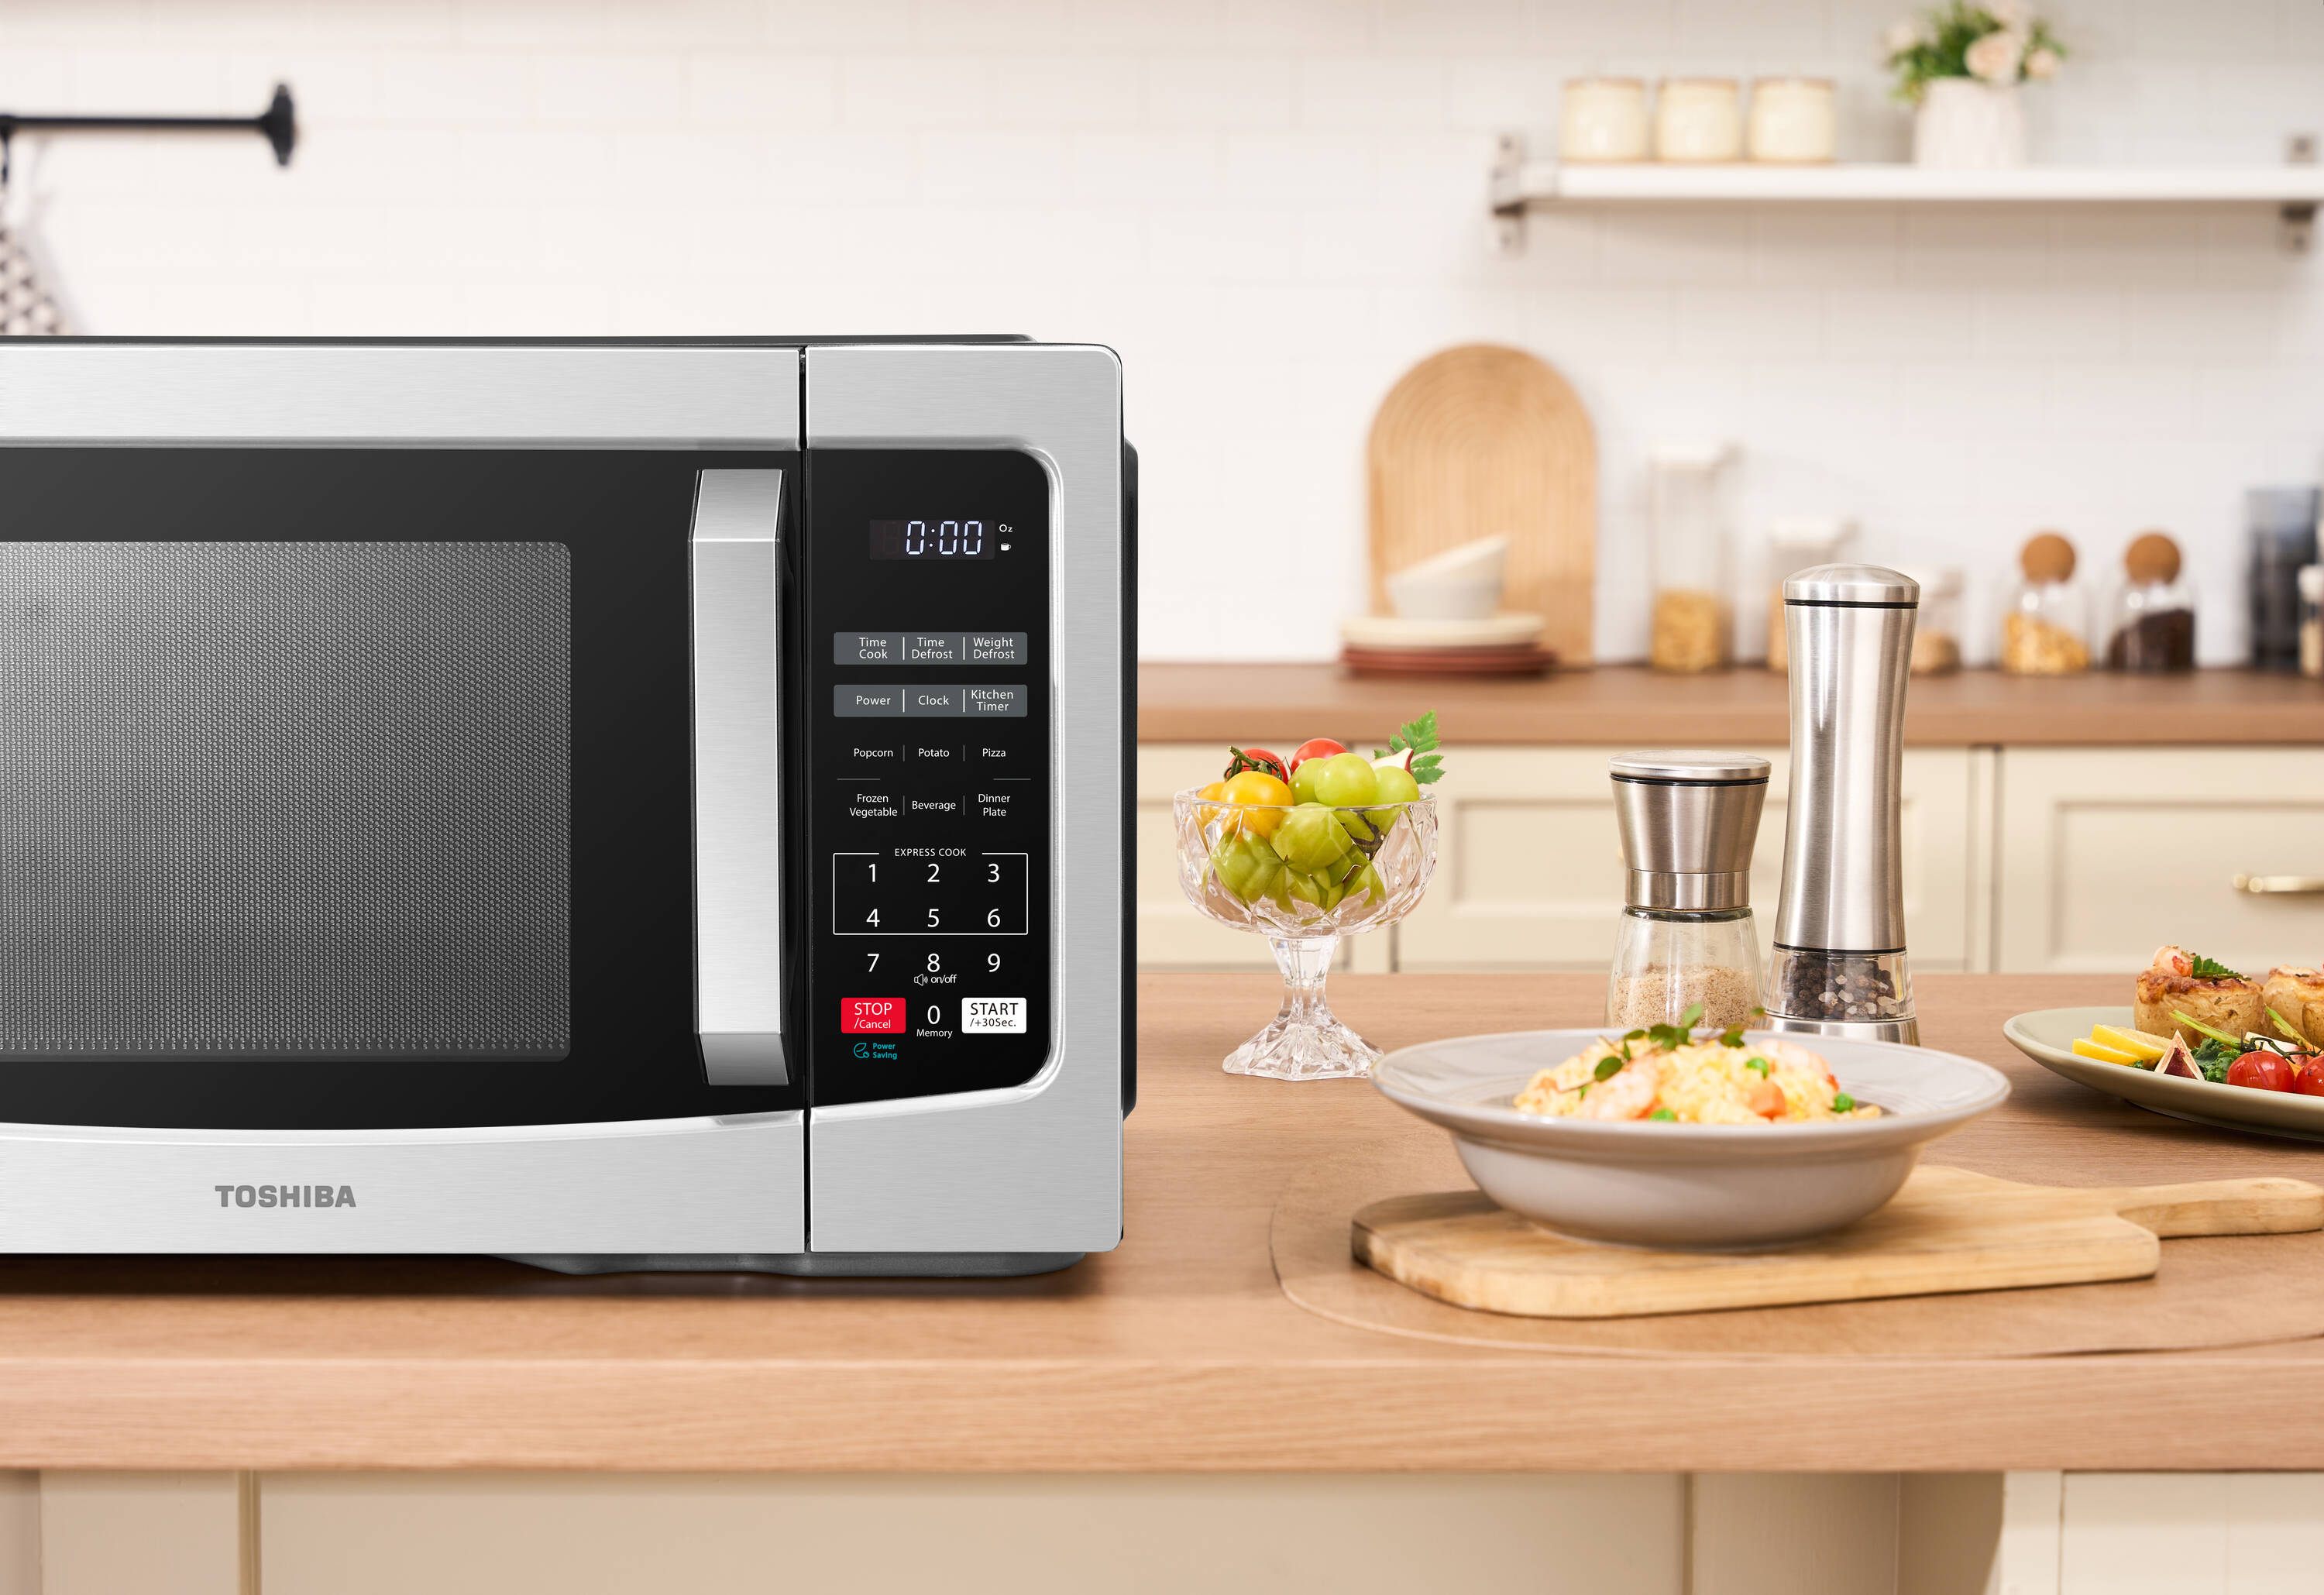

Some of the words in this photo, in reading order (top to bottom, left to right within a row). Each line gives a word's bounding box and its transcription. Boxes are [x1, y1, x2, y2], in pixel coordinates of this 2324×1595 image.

[906, 521, 982, 555] 0:00
[858, 637, 887, 648] Time
[916, 637, 945, 648] Time
[973, 636, 1014, 650] Weight
[858, 648, 888, 659] Cook
[911, 648, 953, 659] Defrost
[973, 648, 1015, 659] Defrost
[971, 689, 1014, 700] Kitchen
[856, 695, 892, 706] Power
[918, 695, 950, 706] Clock
[976, 701, 1009, 711] Timer
[854, 748, 894, 759] Popcorn
[918, 748, 950, 758] Potato
[982, 748, 1006, 758] Pizza
[857, 793, 889, 803] Frozen
[978, 793, 1011, 803] Dinner
[912, 800, 957, 812] Beverage
[983, 806, 1007, 816] Plate
[849, 806, 898, 819] Vegetable
[895, 847, 936, 857] EXPRESS
[938, 847, 967, 857] COOK
[868, 863, 876, 882] 1
[927, 863, 940, 883] 2
[988, 863, 1000, 883] 3
[866, 908, 881, 928] 4
[927, 908, 940, 928] 5
[987, 908, 1001, 928] 6
[867, 953, 880, 972] 7
[927, 953, 940, 973] 8
[987, 953, 1001, 973] 9
[930, 974, 957, 984] on/off
[854, 1002, 892, 1016] STOP
[970, 1002, 1019, 1016] START
[927, 1005, 940, 1025] 0
[854, 1017, 891, 1030] /Cancel
[969, 1017, 1016, 1027] /+30Sec.
[916, 1028, 953, 1040] Memory
[872, 1051, 898, 1060] Saving
[215, 1185, 356, 1208] TOSHIBA
